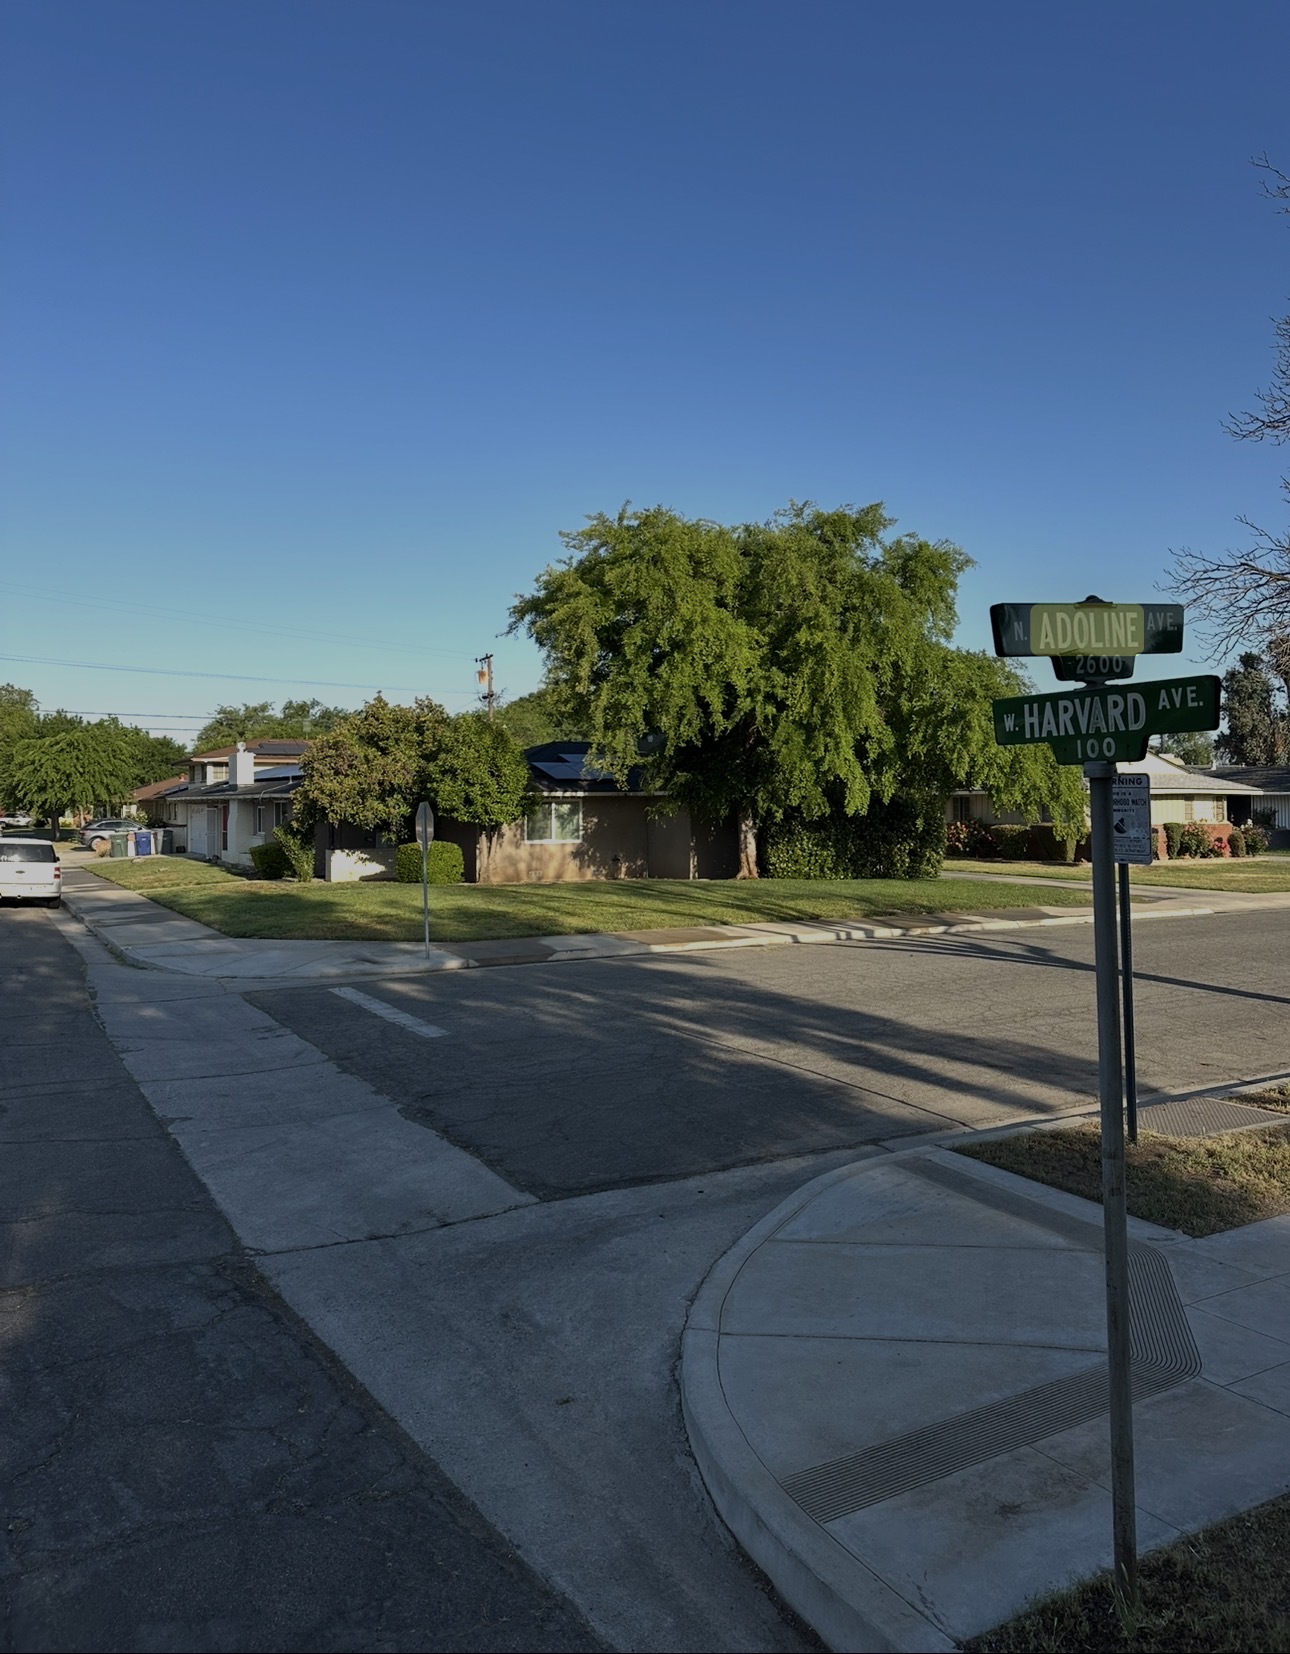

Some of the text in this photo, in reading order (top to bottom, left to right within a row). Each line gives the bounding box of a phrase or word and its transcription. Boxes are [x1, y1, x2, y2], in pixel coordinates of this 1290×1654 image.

[1013, 612, 1178, 650] N. ADOLINE AVE.
[1076, 655, 1123, 674] 2600
[1004, 686, 1204, 739] W. HARVARD AVE.
[1076, 737, 1116, 758] 100
[1112, 777, 1142, 785] RNING
[1131, 798, 1147, 806] WATCH
